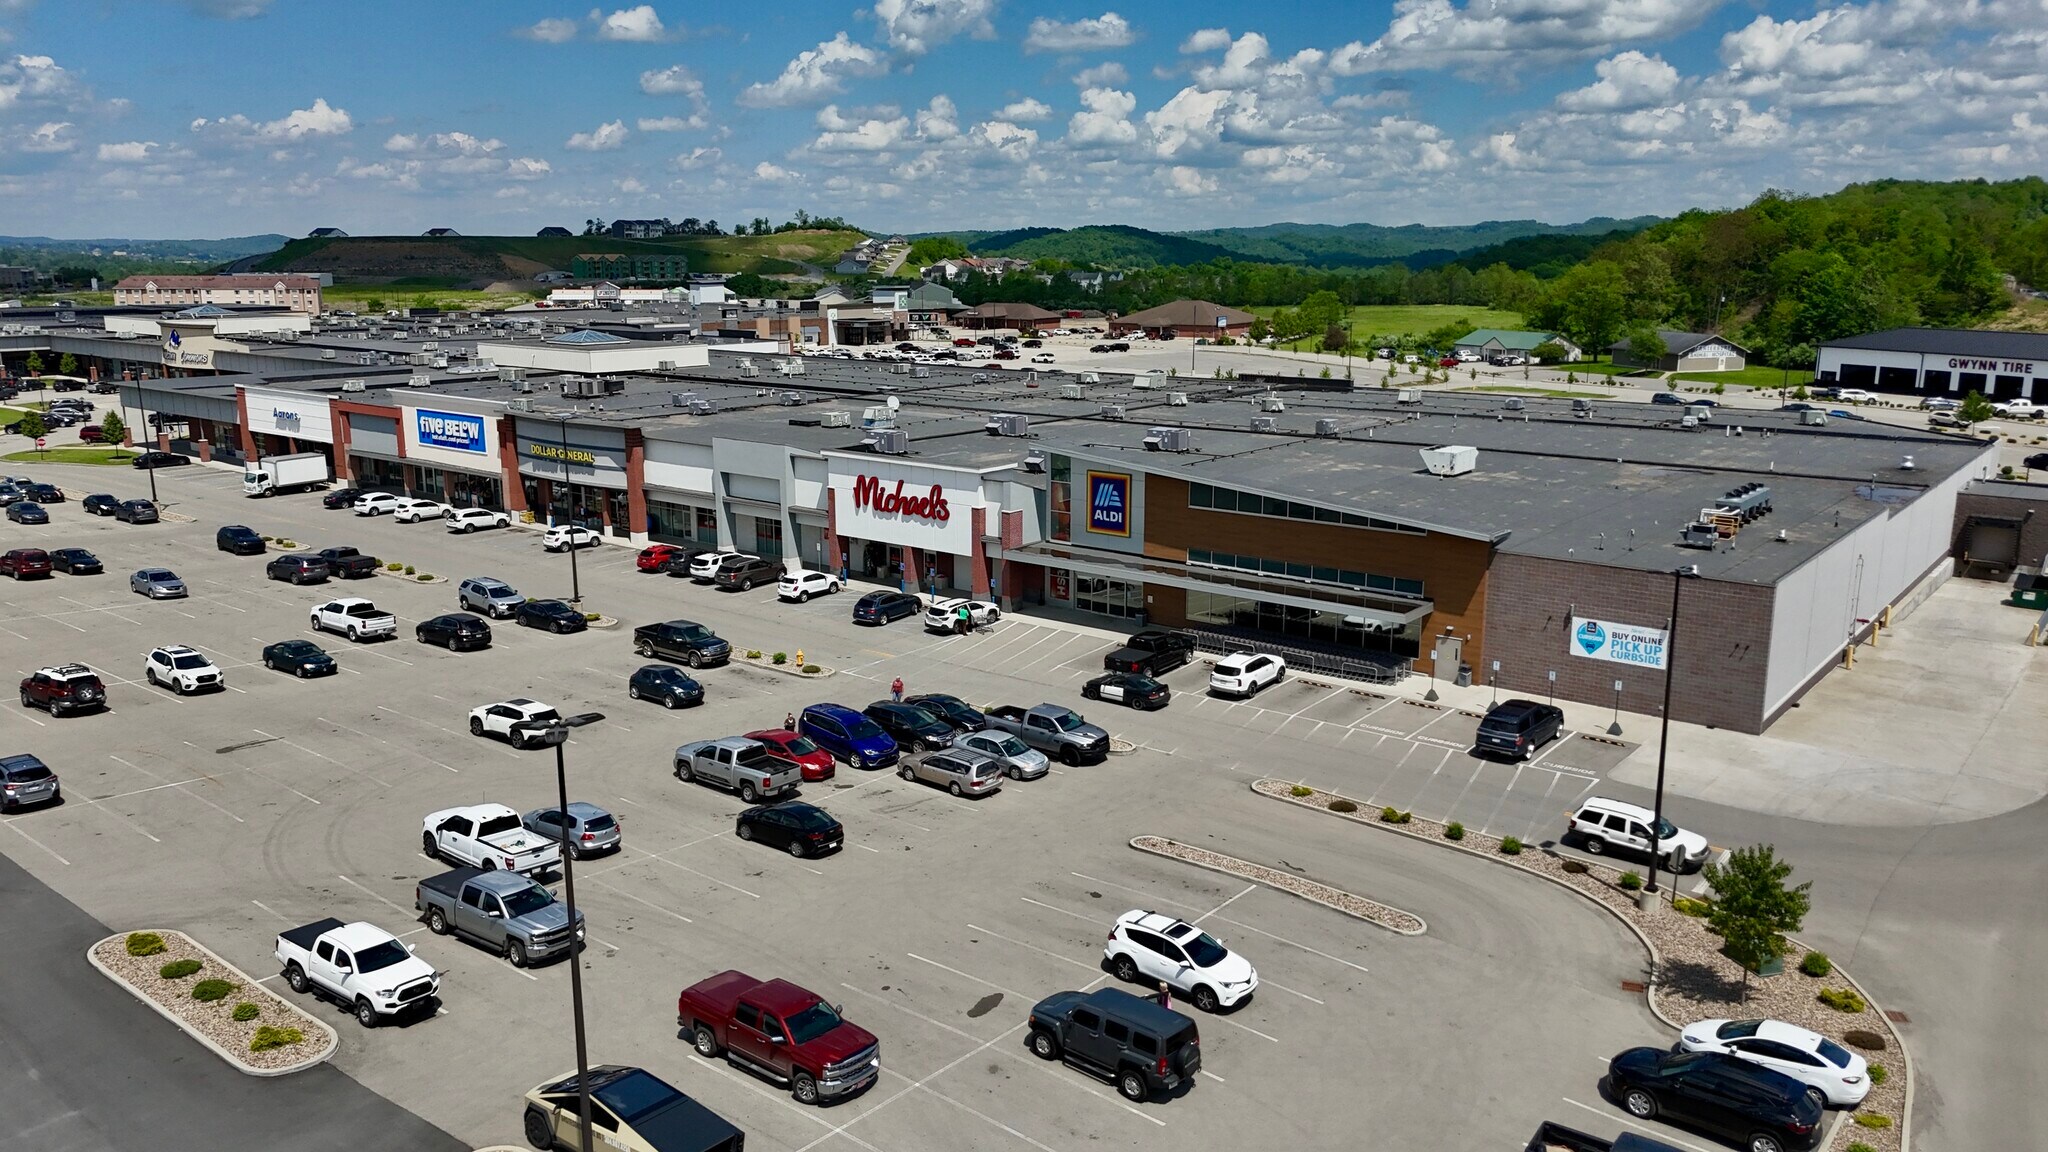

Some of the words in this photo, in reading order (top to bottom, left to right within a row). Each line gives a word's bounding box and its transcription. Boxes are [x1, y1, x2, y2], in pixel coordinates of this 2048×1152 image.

[1948, 358, 1997, 372] GWYNN
[2002, 361, 2033, 374] TIRE
[419, 416, 444, 435] five
[444, 419, 479, 440] BELOW
[530, 444, 557, 458] DOLLAR
[853, 474, 950, 522] Michaels
[1094, 509, 1122, 523] ALDI
[1611, 631, 1630, 640] BUY
[1631, 634, 1663, 646] ONLINE
[1610, 639, 1640, 653] PICK
[1644, 644, 1662, 656] UP
[1610, 649, 1662, 666] CURBSIDE
[1359, 723, 1406, 736] CURBSIDE
[1417, 735, 1467, 748] CURBSIDE
[1542, 761, 1596, 776] CURBSIDE
